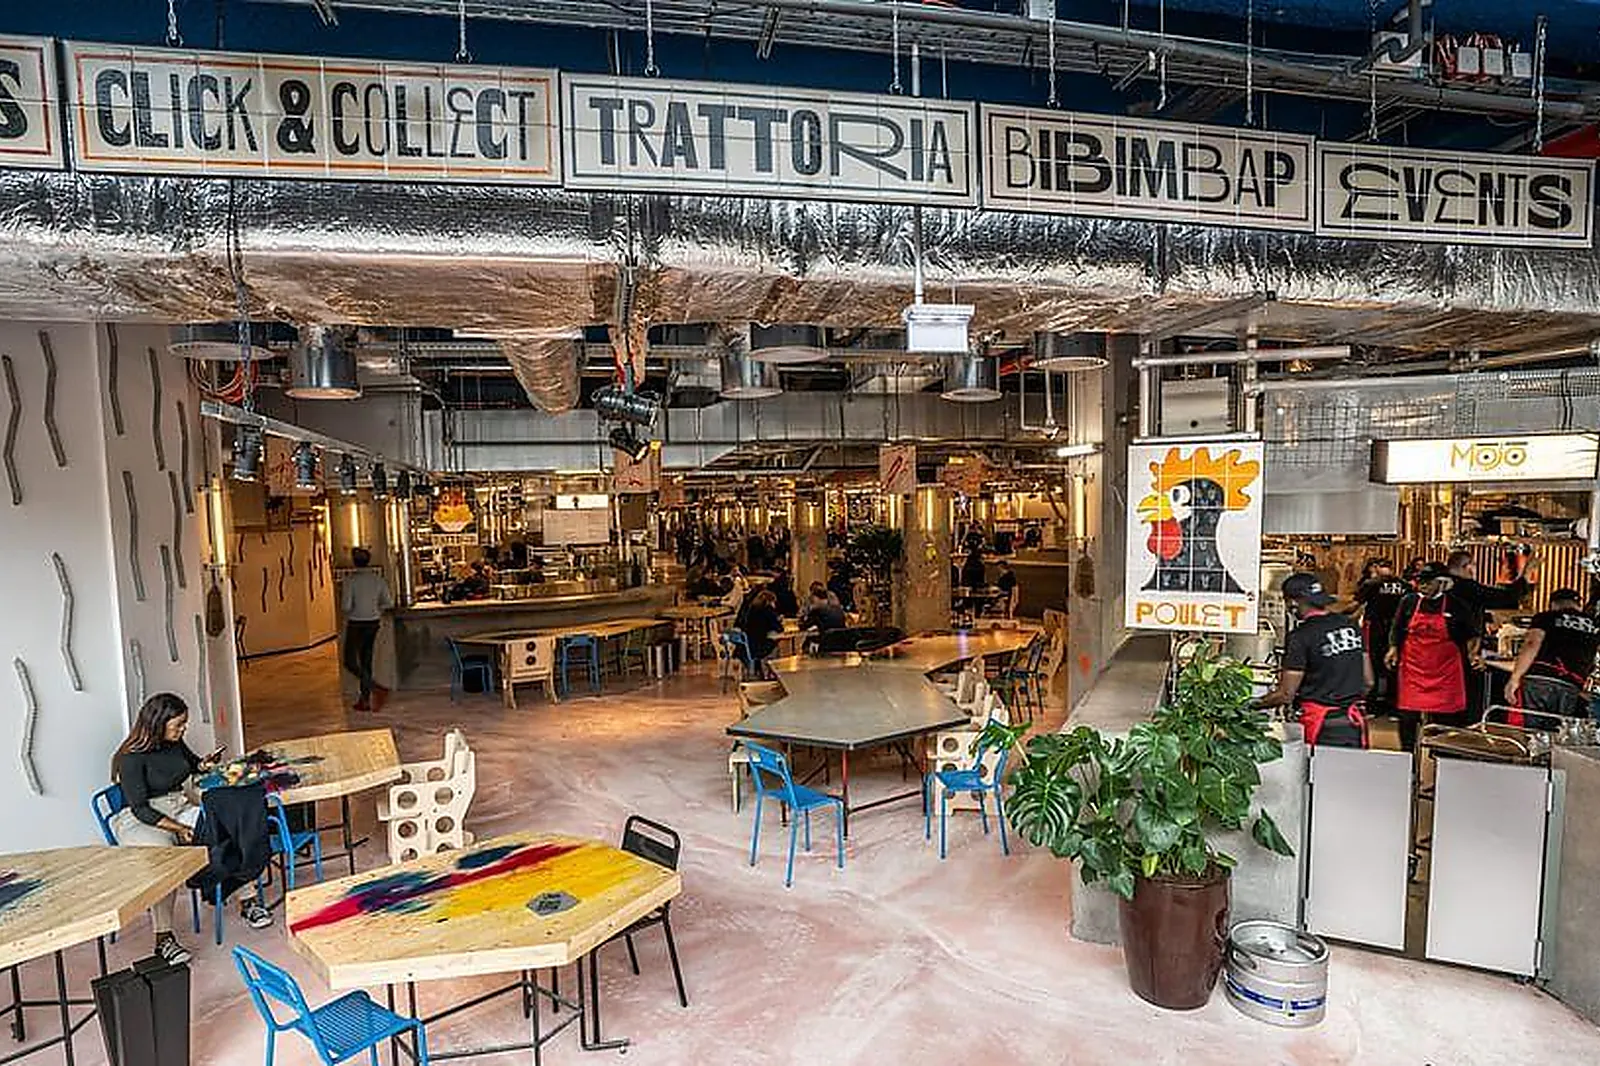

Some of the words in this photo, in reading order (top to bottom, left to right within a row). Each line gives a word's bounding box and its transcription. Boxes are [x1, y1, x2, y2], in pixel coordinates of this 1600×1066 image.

[95, 69, 258, 152] CLICK
[276, 79, 316, 153] &
[331, 82, 536, 161] COLLECT
[589, 96, 954, 184] TRATTORIA
[1006, 126, 1295, 208] BIBIMBAP
[1339, 162, 1572, 229] EVENTS
[1136, 602, 1247, 628] POULET
